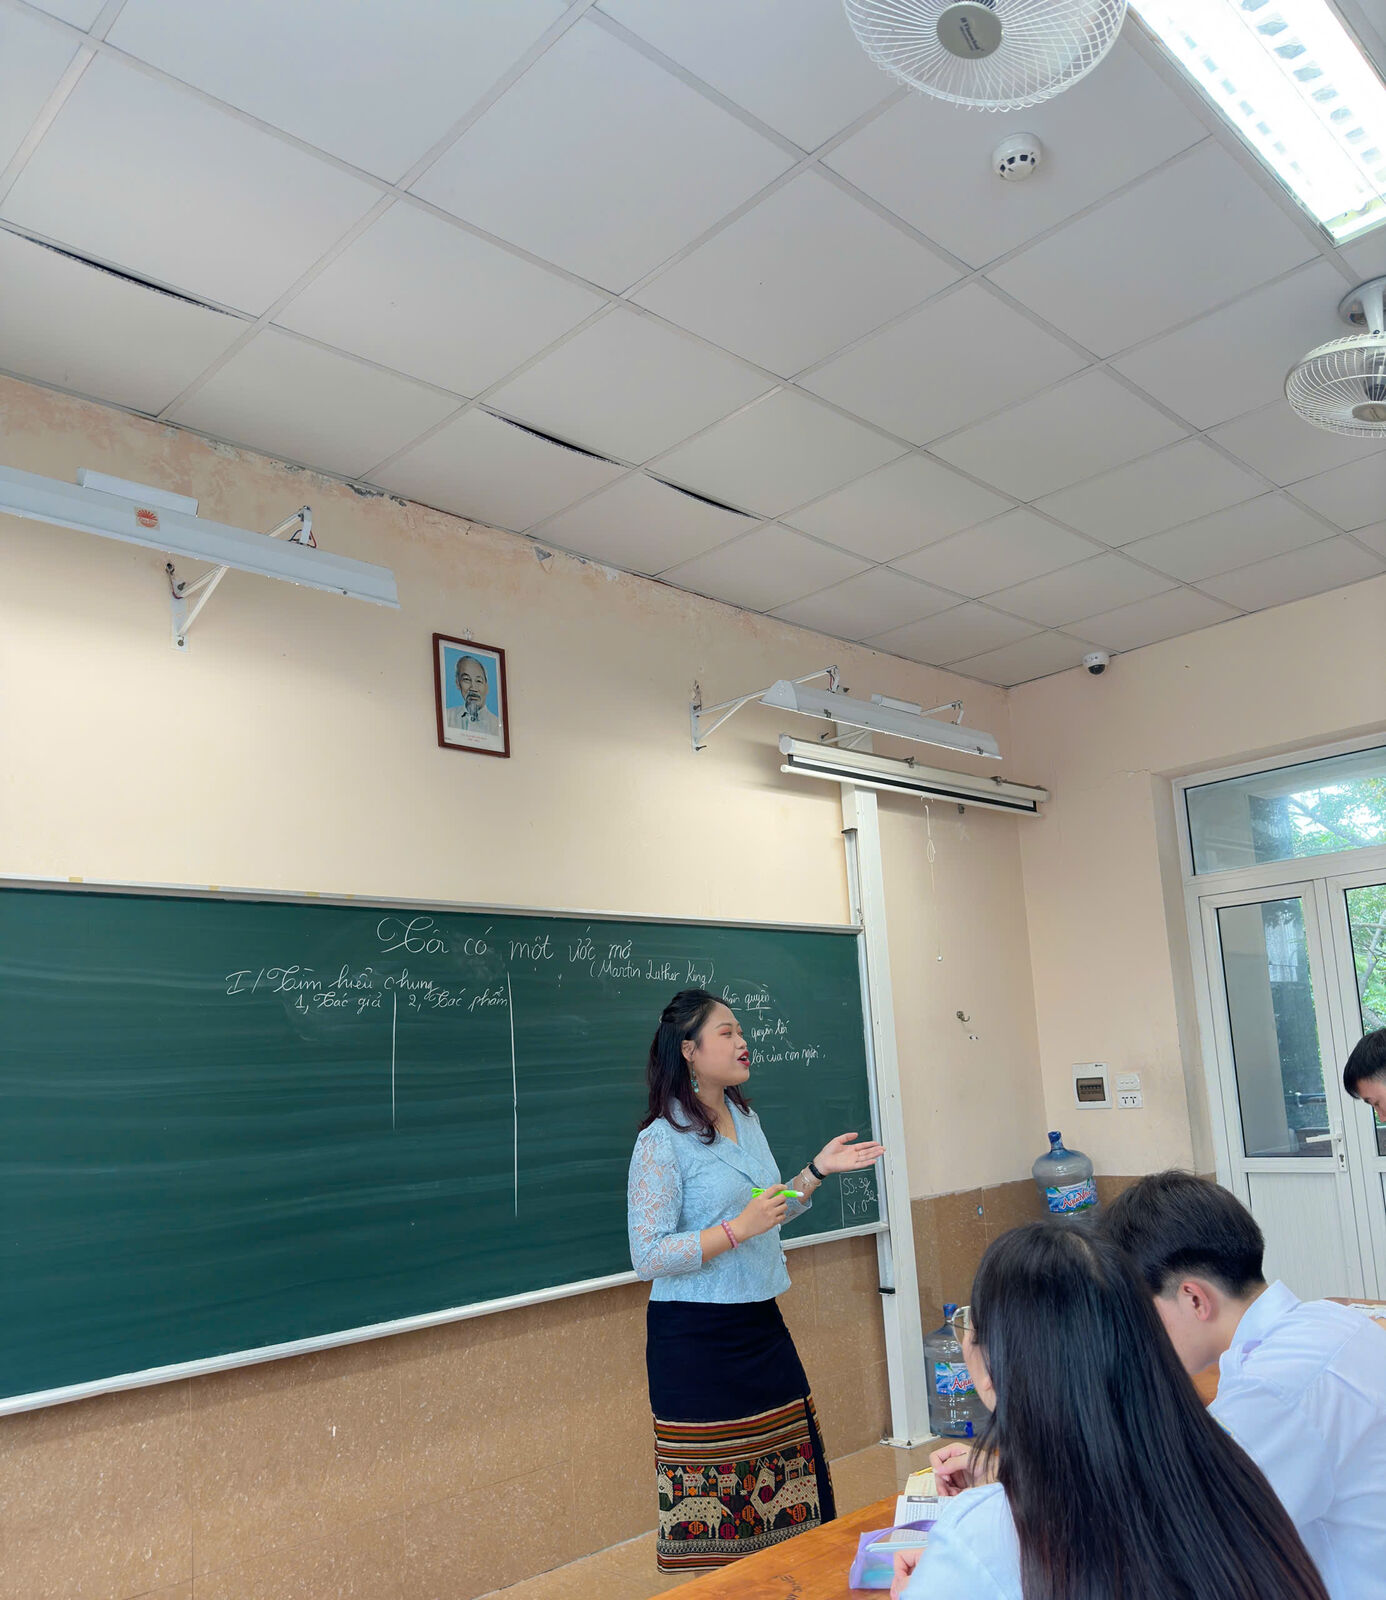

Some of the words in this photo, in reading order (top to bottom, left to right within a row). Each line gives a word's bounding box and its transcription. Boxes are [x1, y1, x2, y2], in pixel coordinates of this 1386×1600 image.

[376, 916, 449, 954] Tôi
[464, 926, 493, 956] có
[508, 934, 555, 972] một
[608, 939, 633, 960] mơ
[645, 959, 681, 981] Luther
[266, 965, 322, 993] Tìm
[328, 964, 373, 989] hiểu
[383, 967, 440, 1001] chung
[722, 984, 740, 1004] hân
[313, 991, 349, 1009] Tác
[357, 991, 382, 1015] giả
[426, 987, 467, 1009] Tác
[467, 986, 508, 1013] phẩm
[784, 1050, 800, 1062] con
